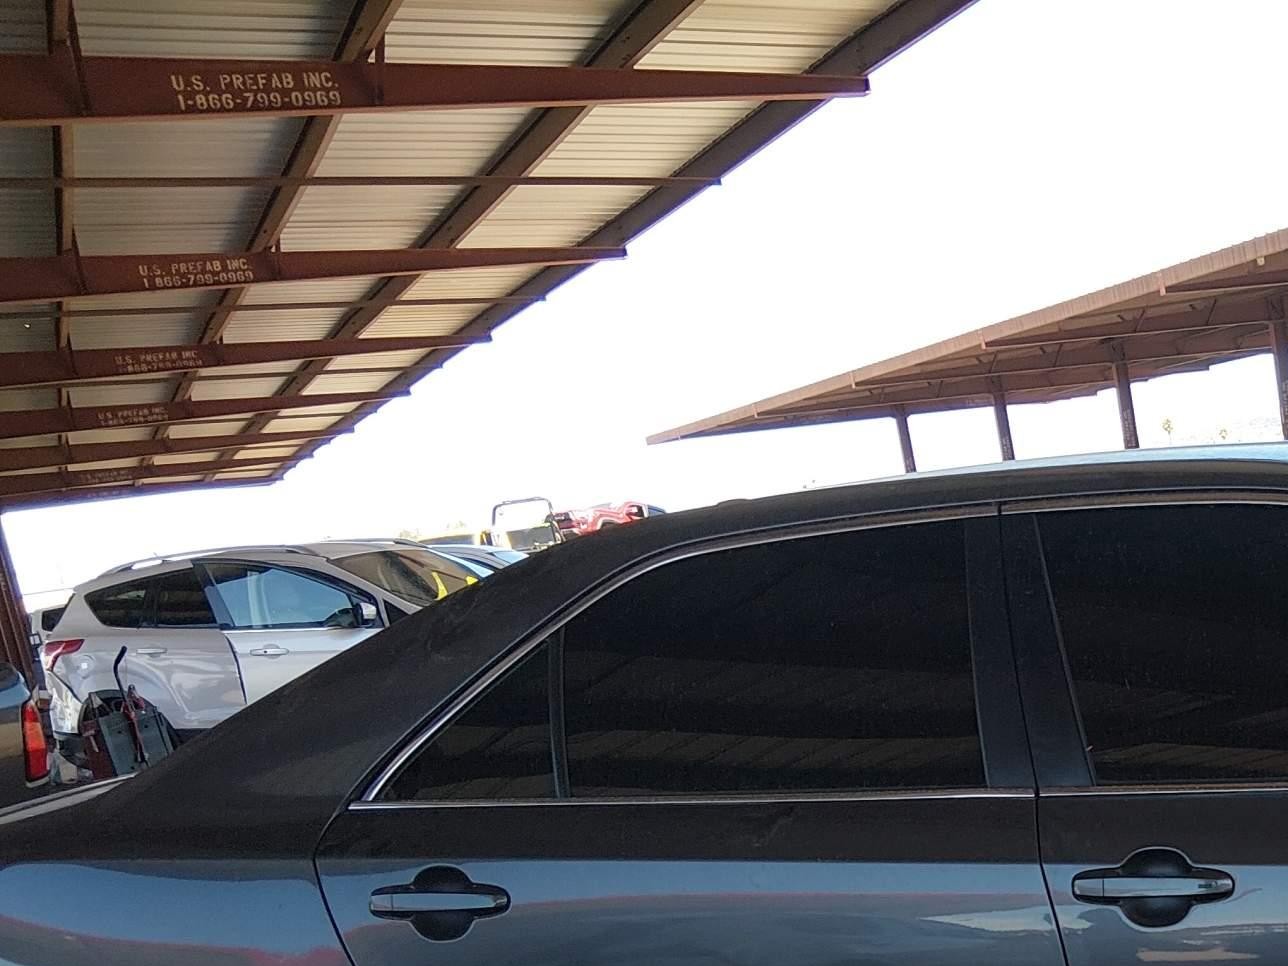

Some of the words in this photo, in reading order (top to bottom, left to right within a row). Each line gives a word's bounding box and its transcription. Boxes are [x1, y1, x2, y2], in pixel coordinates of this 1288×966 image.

[169, 74, 211, 91] U.S.
[219, 72, 295, 90] PREFAB
[303, 71, 339, 89] INC.
[177, 90, 342, 111] 1-866-799-0969
[138, 264, 166, 276] U.S.
[171, 260, 222, 274] PREFAB
